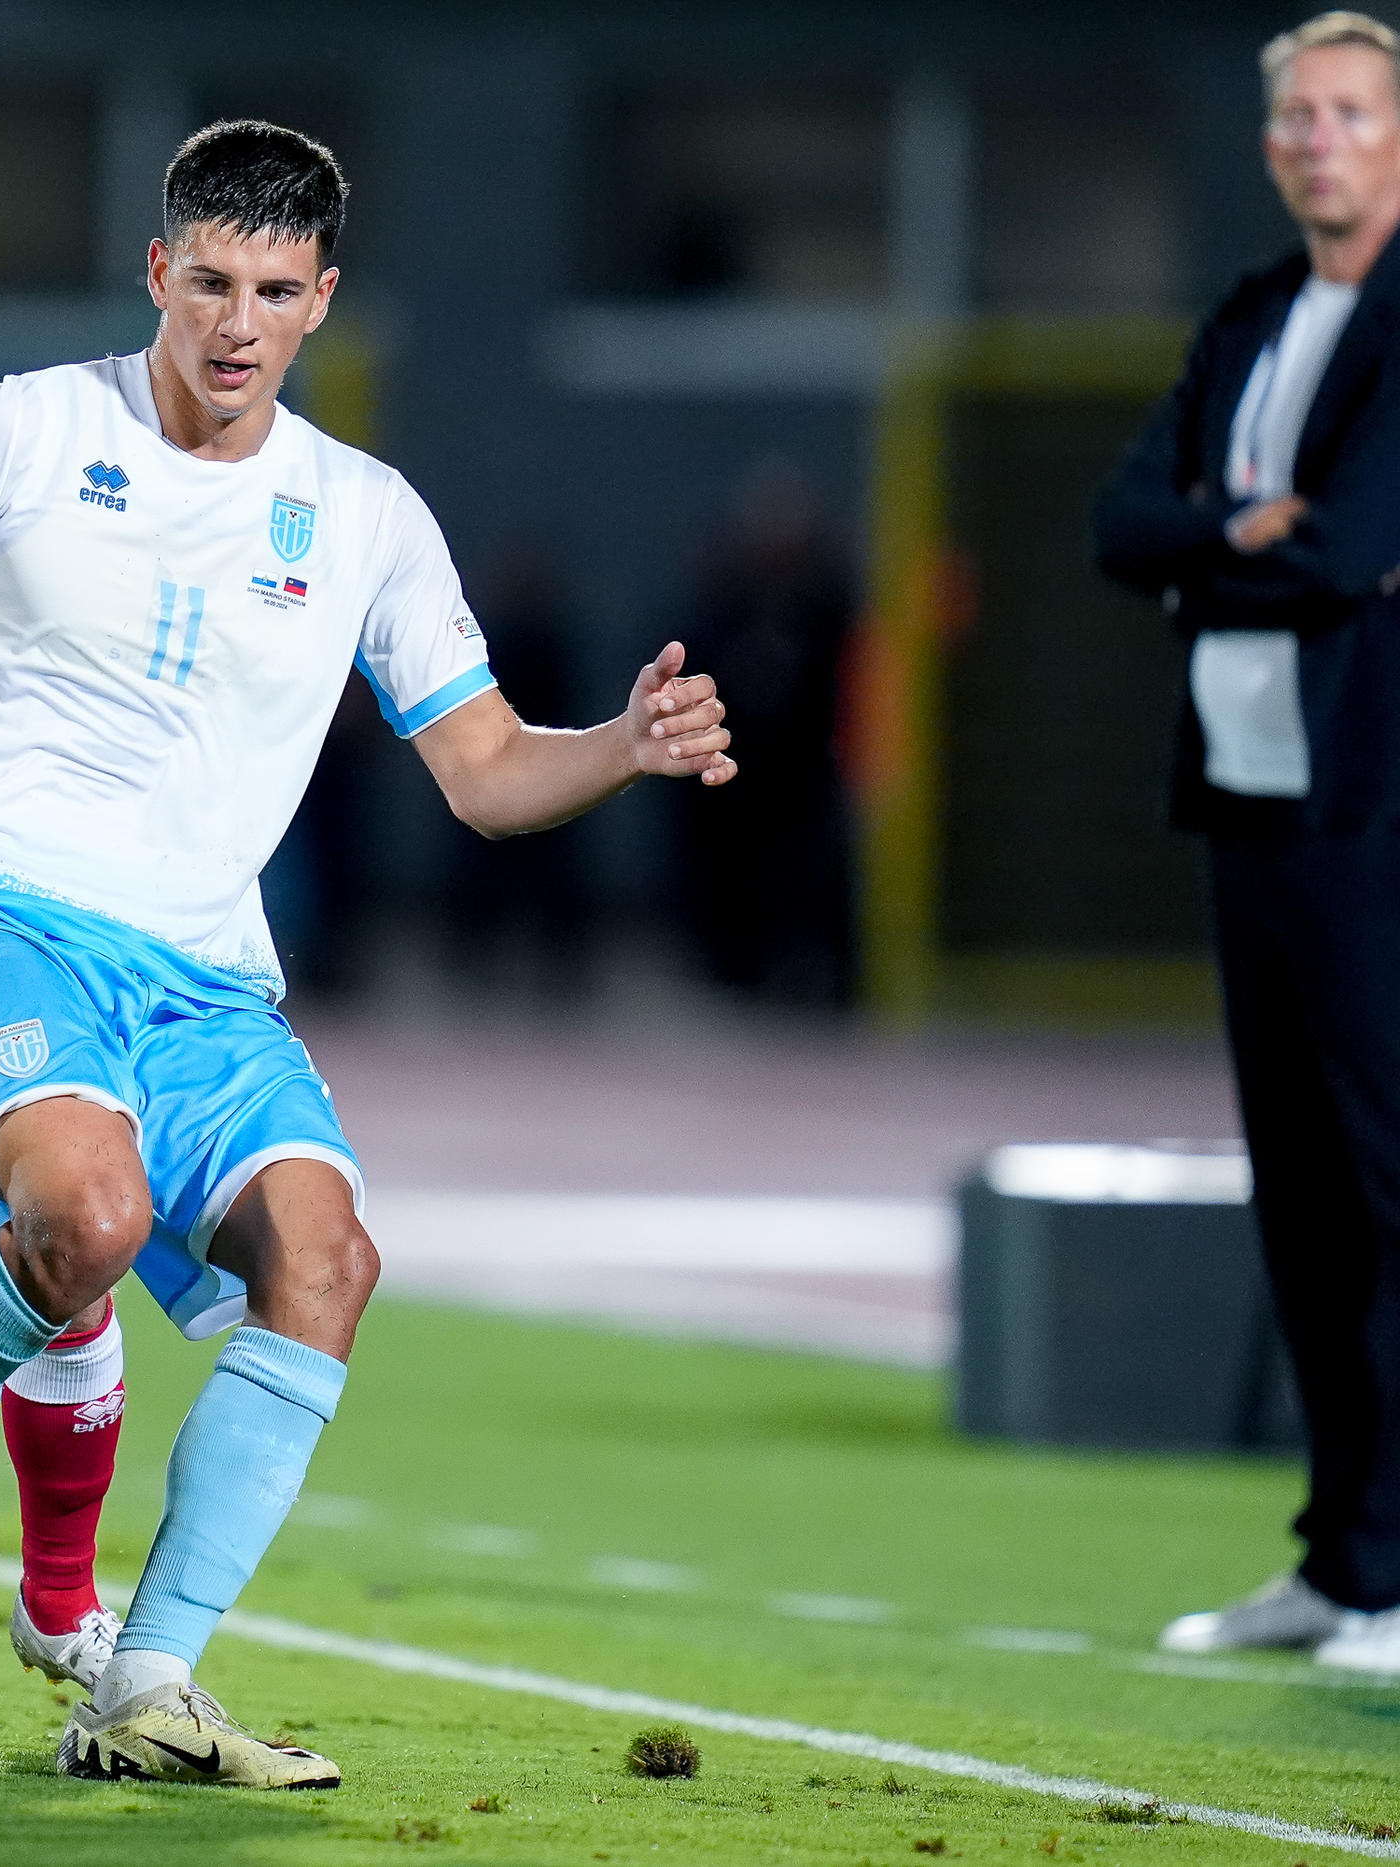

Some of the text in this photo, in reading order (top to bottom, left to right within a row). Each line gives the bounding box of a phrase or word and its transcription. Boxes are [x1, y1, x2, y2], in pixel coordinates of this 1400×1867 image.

[79, 487, 127, 512] errea
[274, 492, 317, 510] SAN MARINO
[247, 586, 307, 608] SAN MARINO STADIUM
[146, 580, 206, 687] 11
